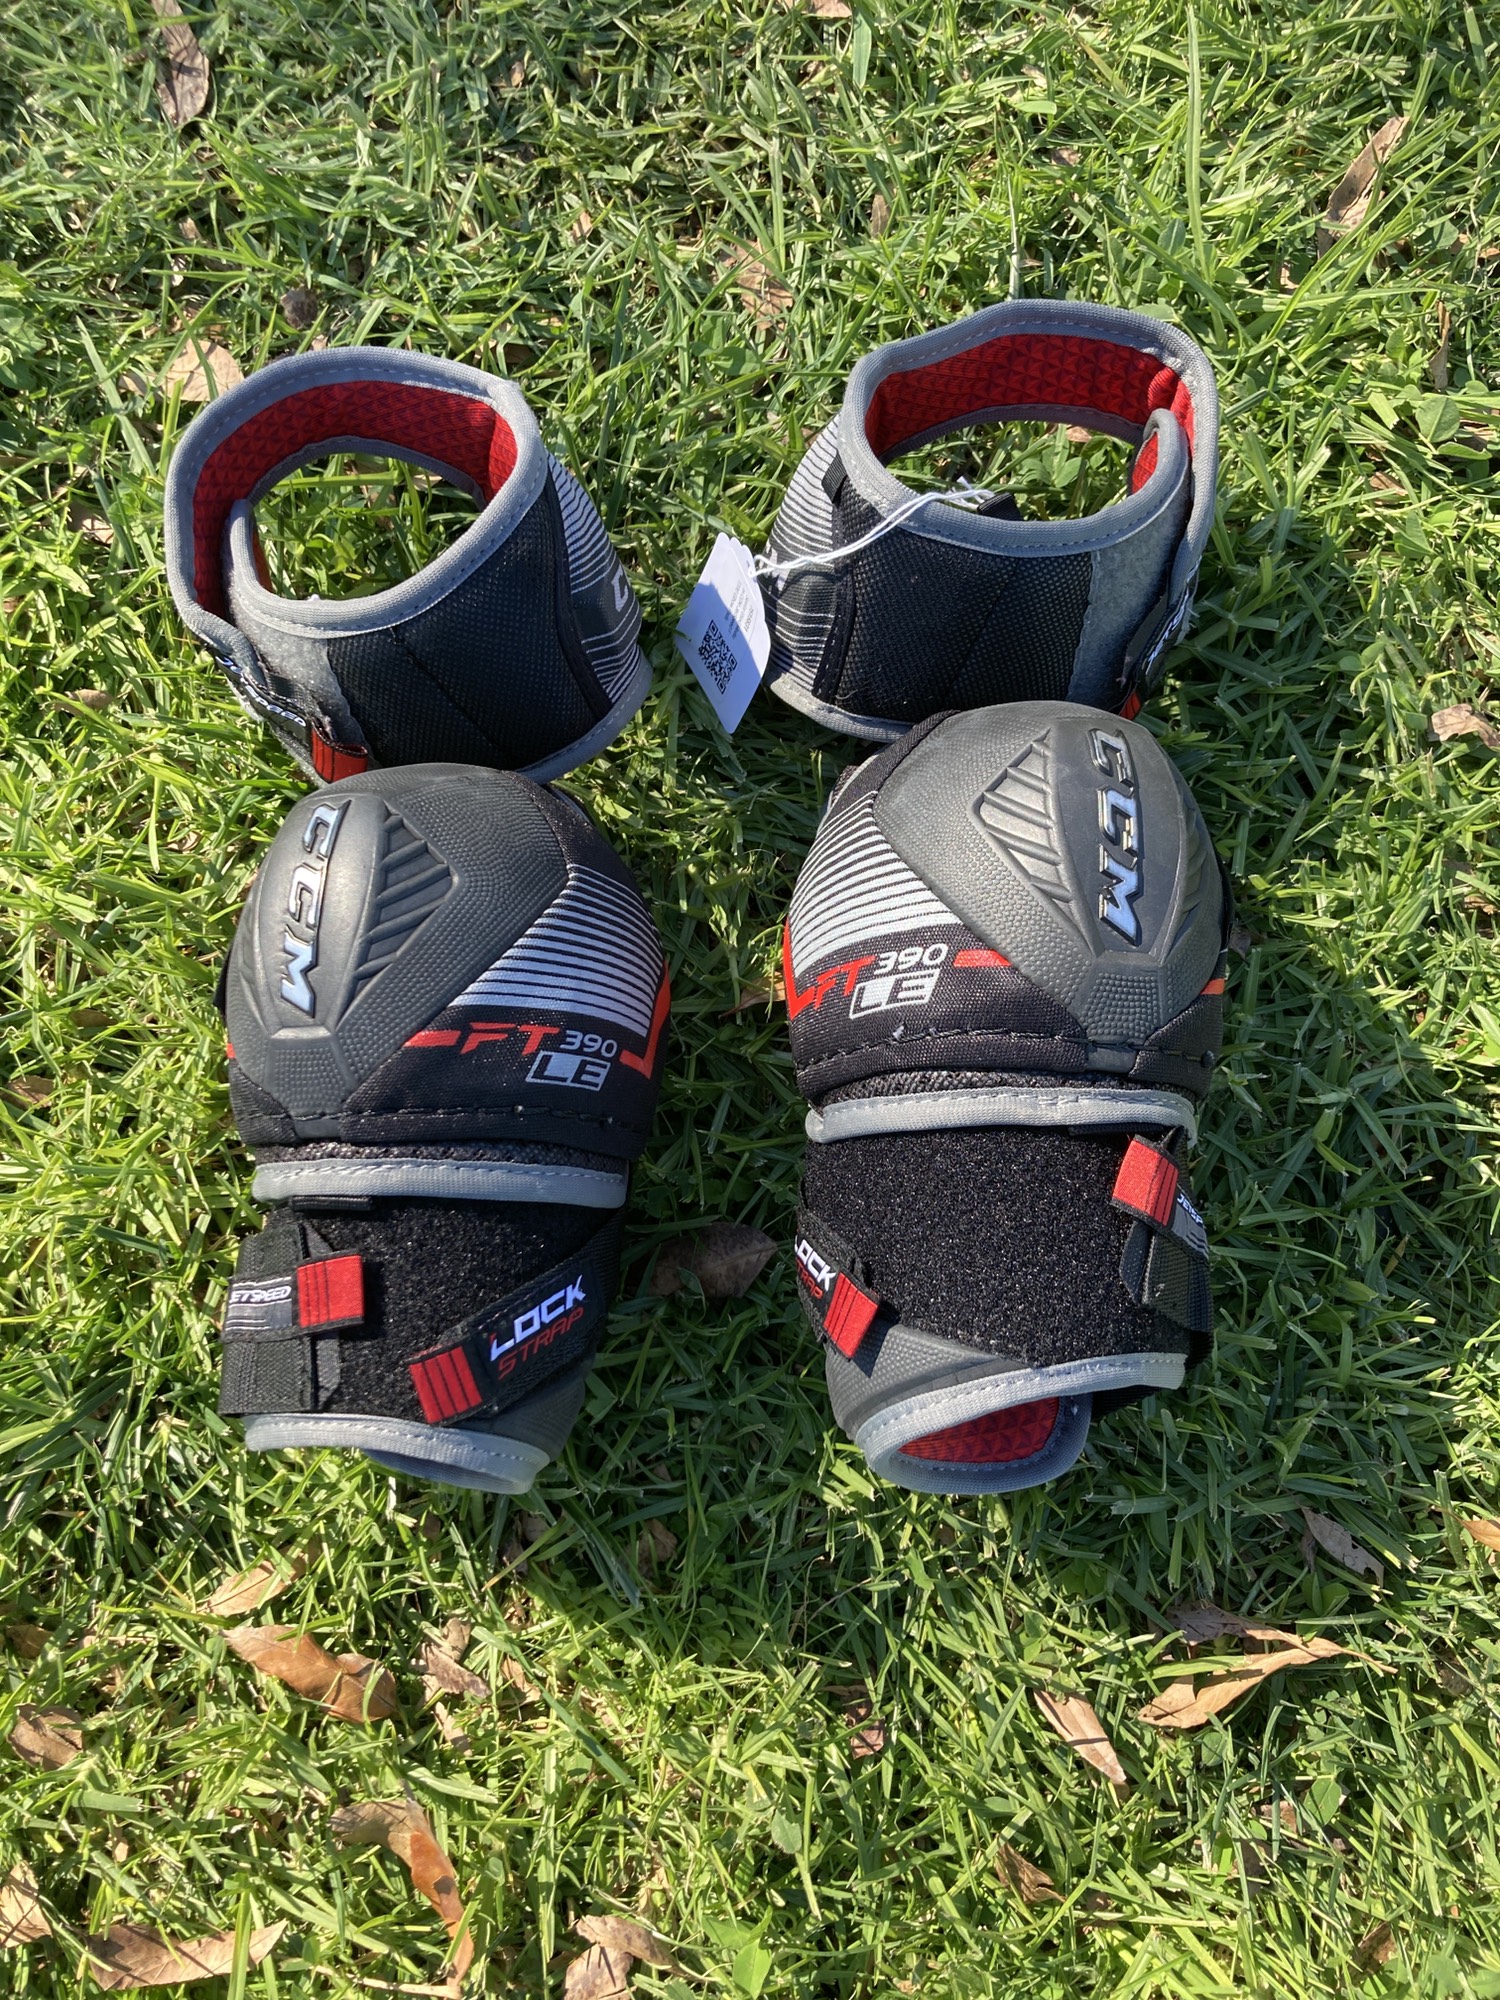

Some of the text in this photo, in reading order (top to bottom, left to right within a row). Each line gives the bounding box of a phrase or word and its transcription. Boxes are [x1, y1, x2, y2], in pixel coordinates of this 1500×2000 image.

[1088, 728, 1143, 947] CCM
[280, 801, 350, 1018] CCM
[873, 943, 948, 975] 390
[850, 968, 940, 1019] LE
[526, 1050, 611, 1092] LE
[560, 1030, 617, 1058] 390
[490, 1274, 586, 1361] LOCK
[498, 1307, 584, 1380] STRAP
